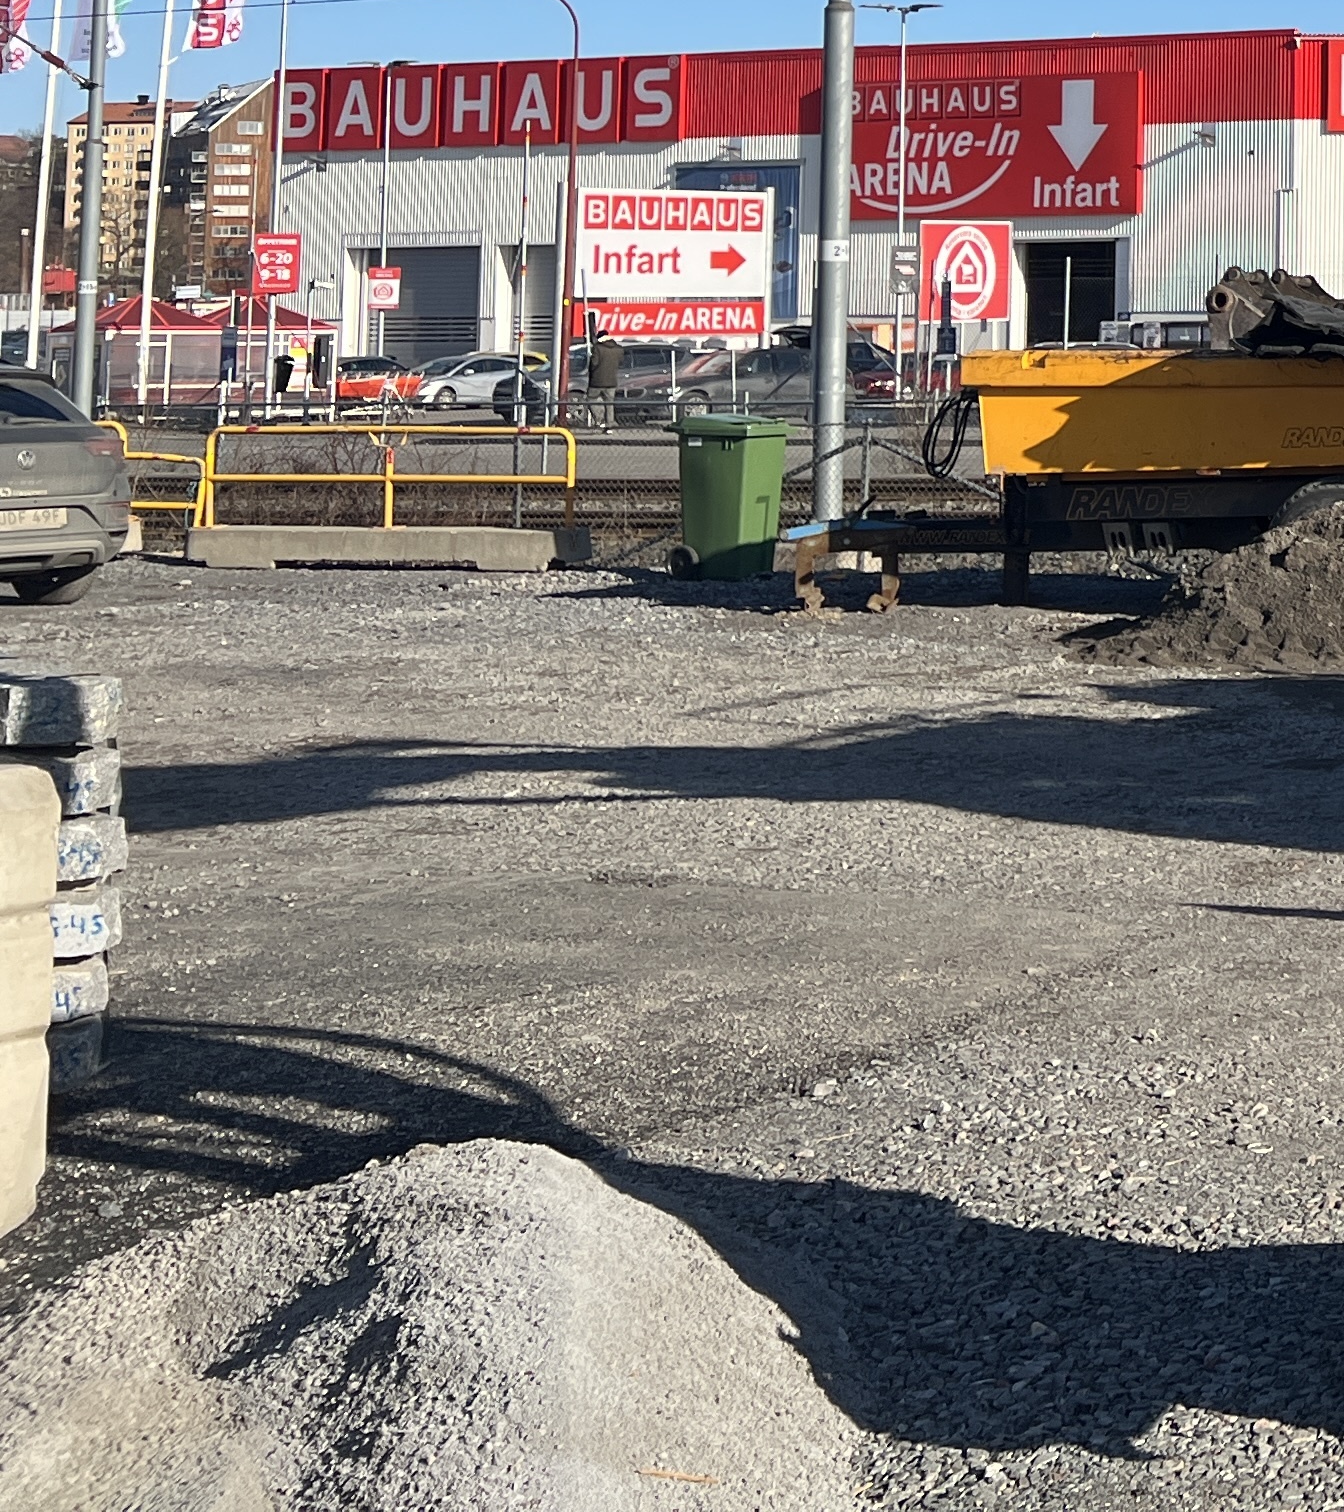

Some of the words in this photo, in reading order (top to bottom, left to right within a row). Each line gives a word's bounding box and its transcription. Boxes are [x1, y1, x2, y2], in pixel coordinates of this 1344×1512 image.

[283, 67, 673, 139] BAUHAUS
[885, 122, 1021, 159] Drive-In
[850, 160, 952, 197] ARENA
[1033, 174, 1120, 208] Infart
[588, 199, 761, 227] BAUHAUS
[593, 244, 681, 274] Infart
[680, 306, 756, 331] ARENA
